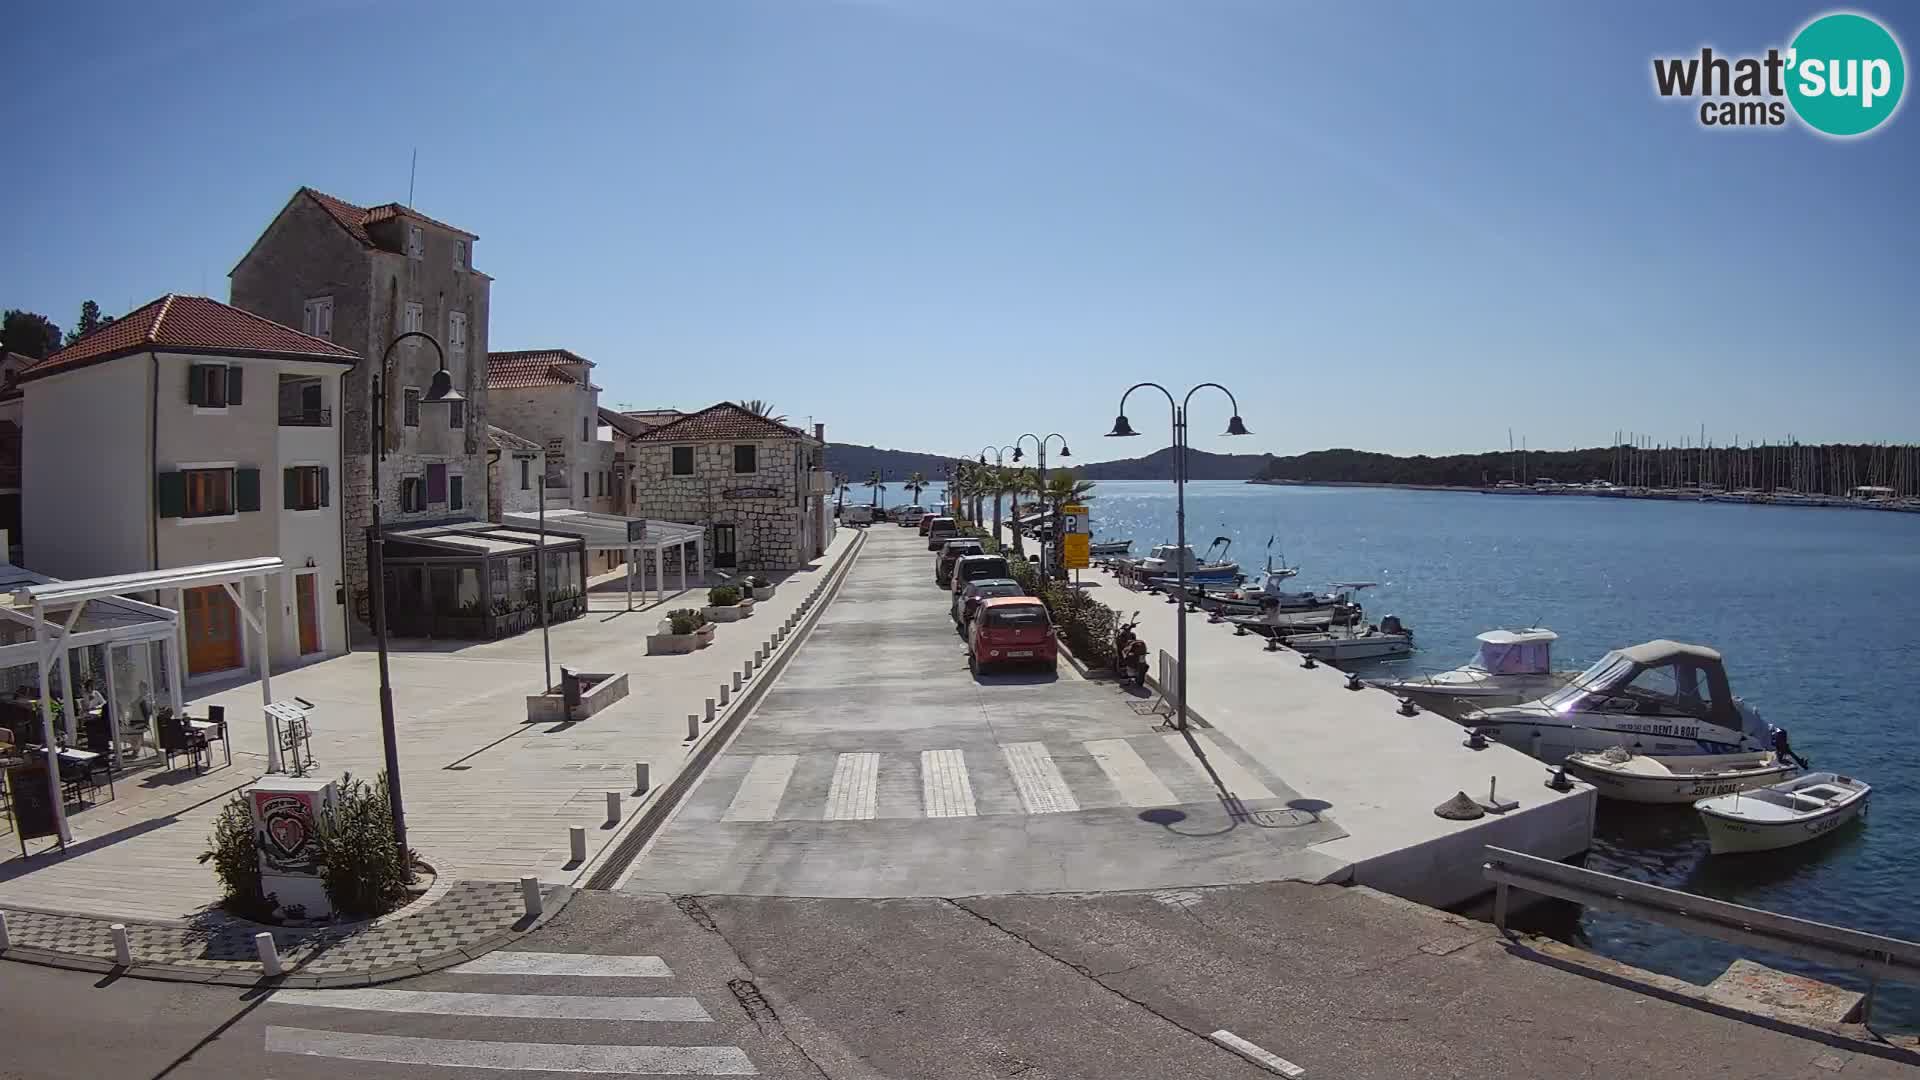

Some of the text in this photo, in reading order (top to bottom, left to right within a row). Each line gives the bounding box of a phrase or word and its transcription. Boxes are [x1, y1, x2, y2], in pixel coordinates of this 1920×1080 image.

[1066, 516, 1076, 532] P
[1652, 724, 1672, 736] RENT
[1673, 725, 1679, 737] A
[1680, 726, 1700, 738] BOAT
